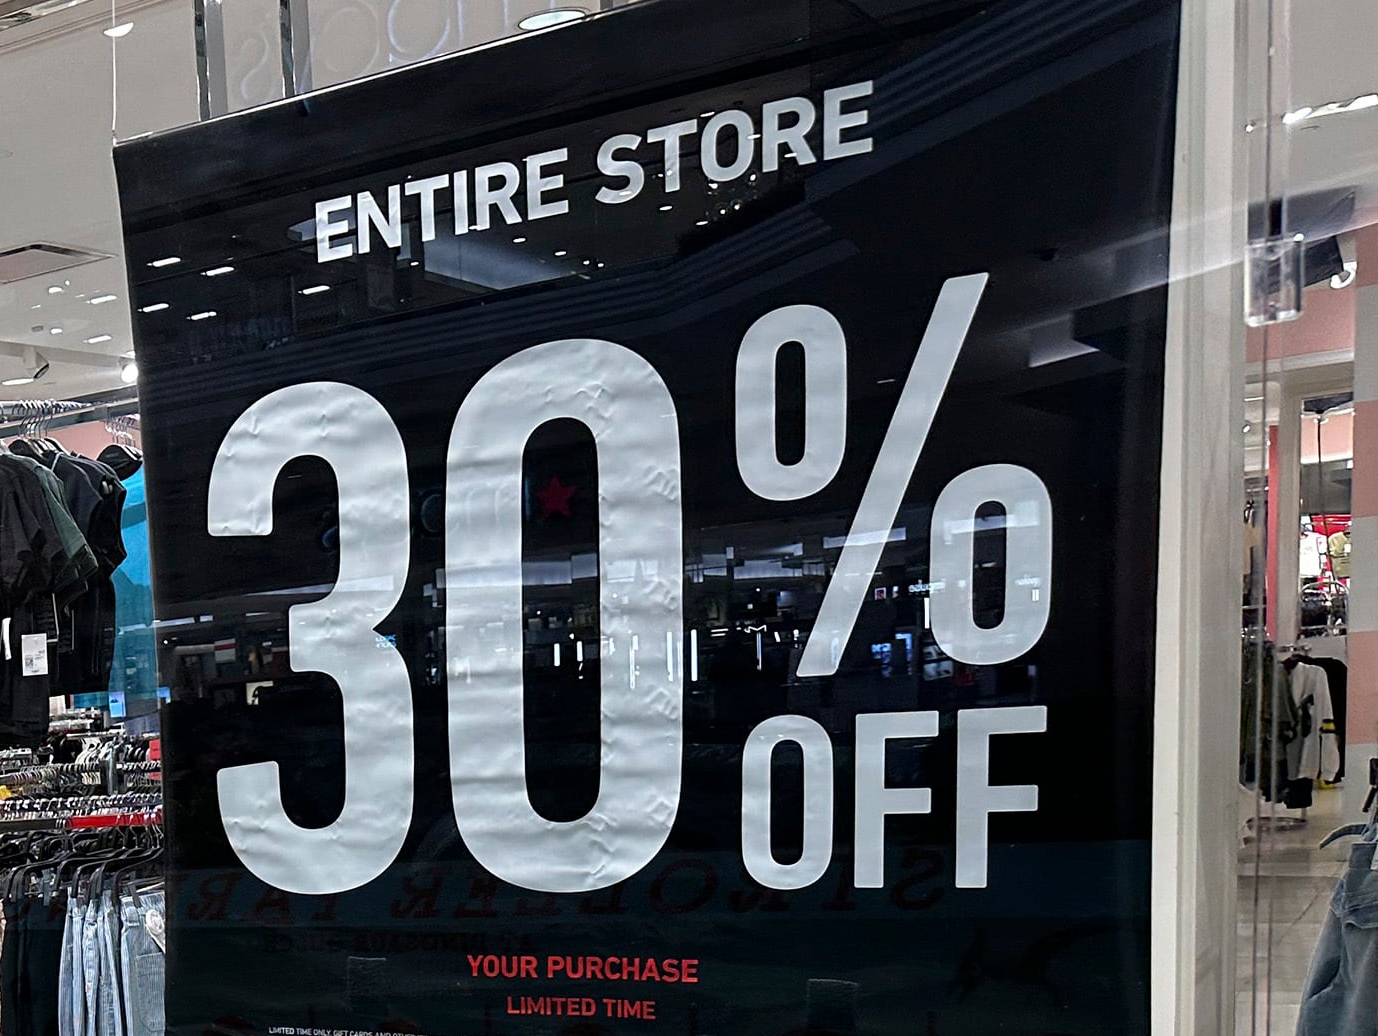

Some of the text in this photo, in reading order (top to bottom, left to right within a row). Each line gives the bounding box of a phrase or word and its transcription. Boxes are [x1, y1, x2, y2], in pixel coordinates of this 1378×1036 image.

[314, 80, 873, 264] ENTIRE STORE
[207, 271, 1053, 895] 30%
[741, 705, 1048, 893] OFF
[467, 954, 699, 984] YOUR PURCHASE
[507, 996, 656, 1020] LIMITED TIME
[268, 1026, 295, 1036] LIMITED
[295, 1027, 312, 1036] TIME
